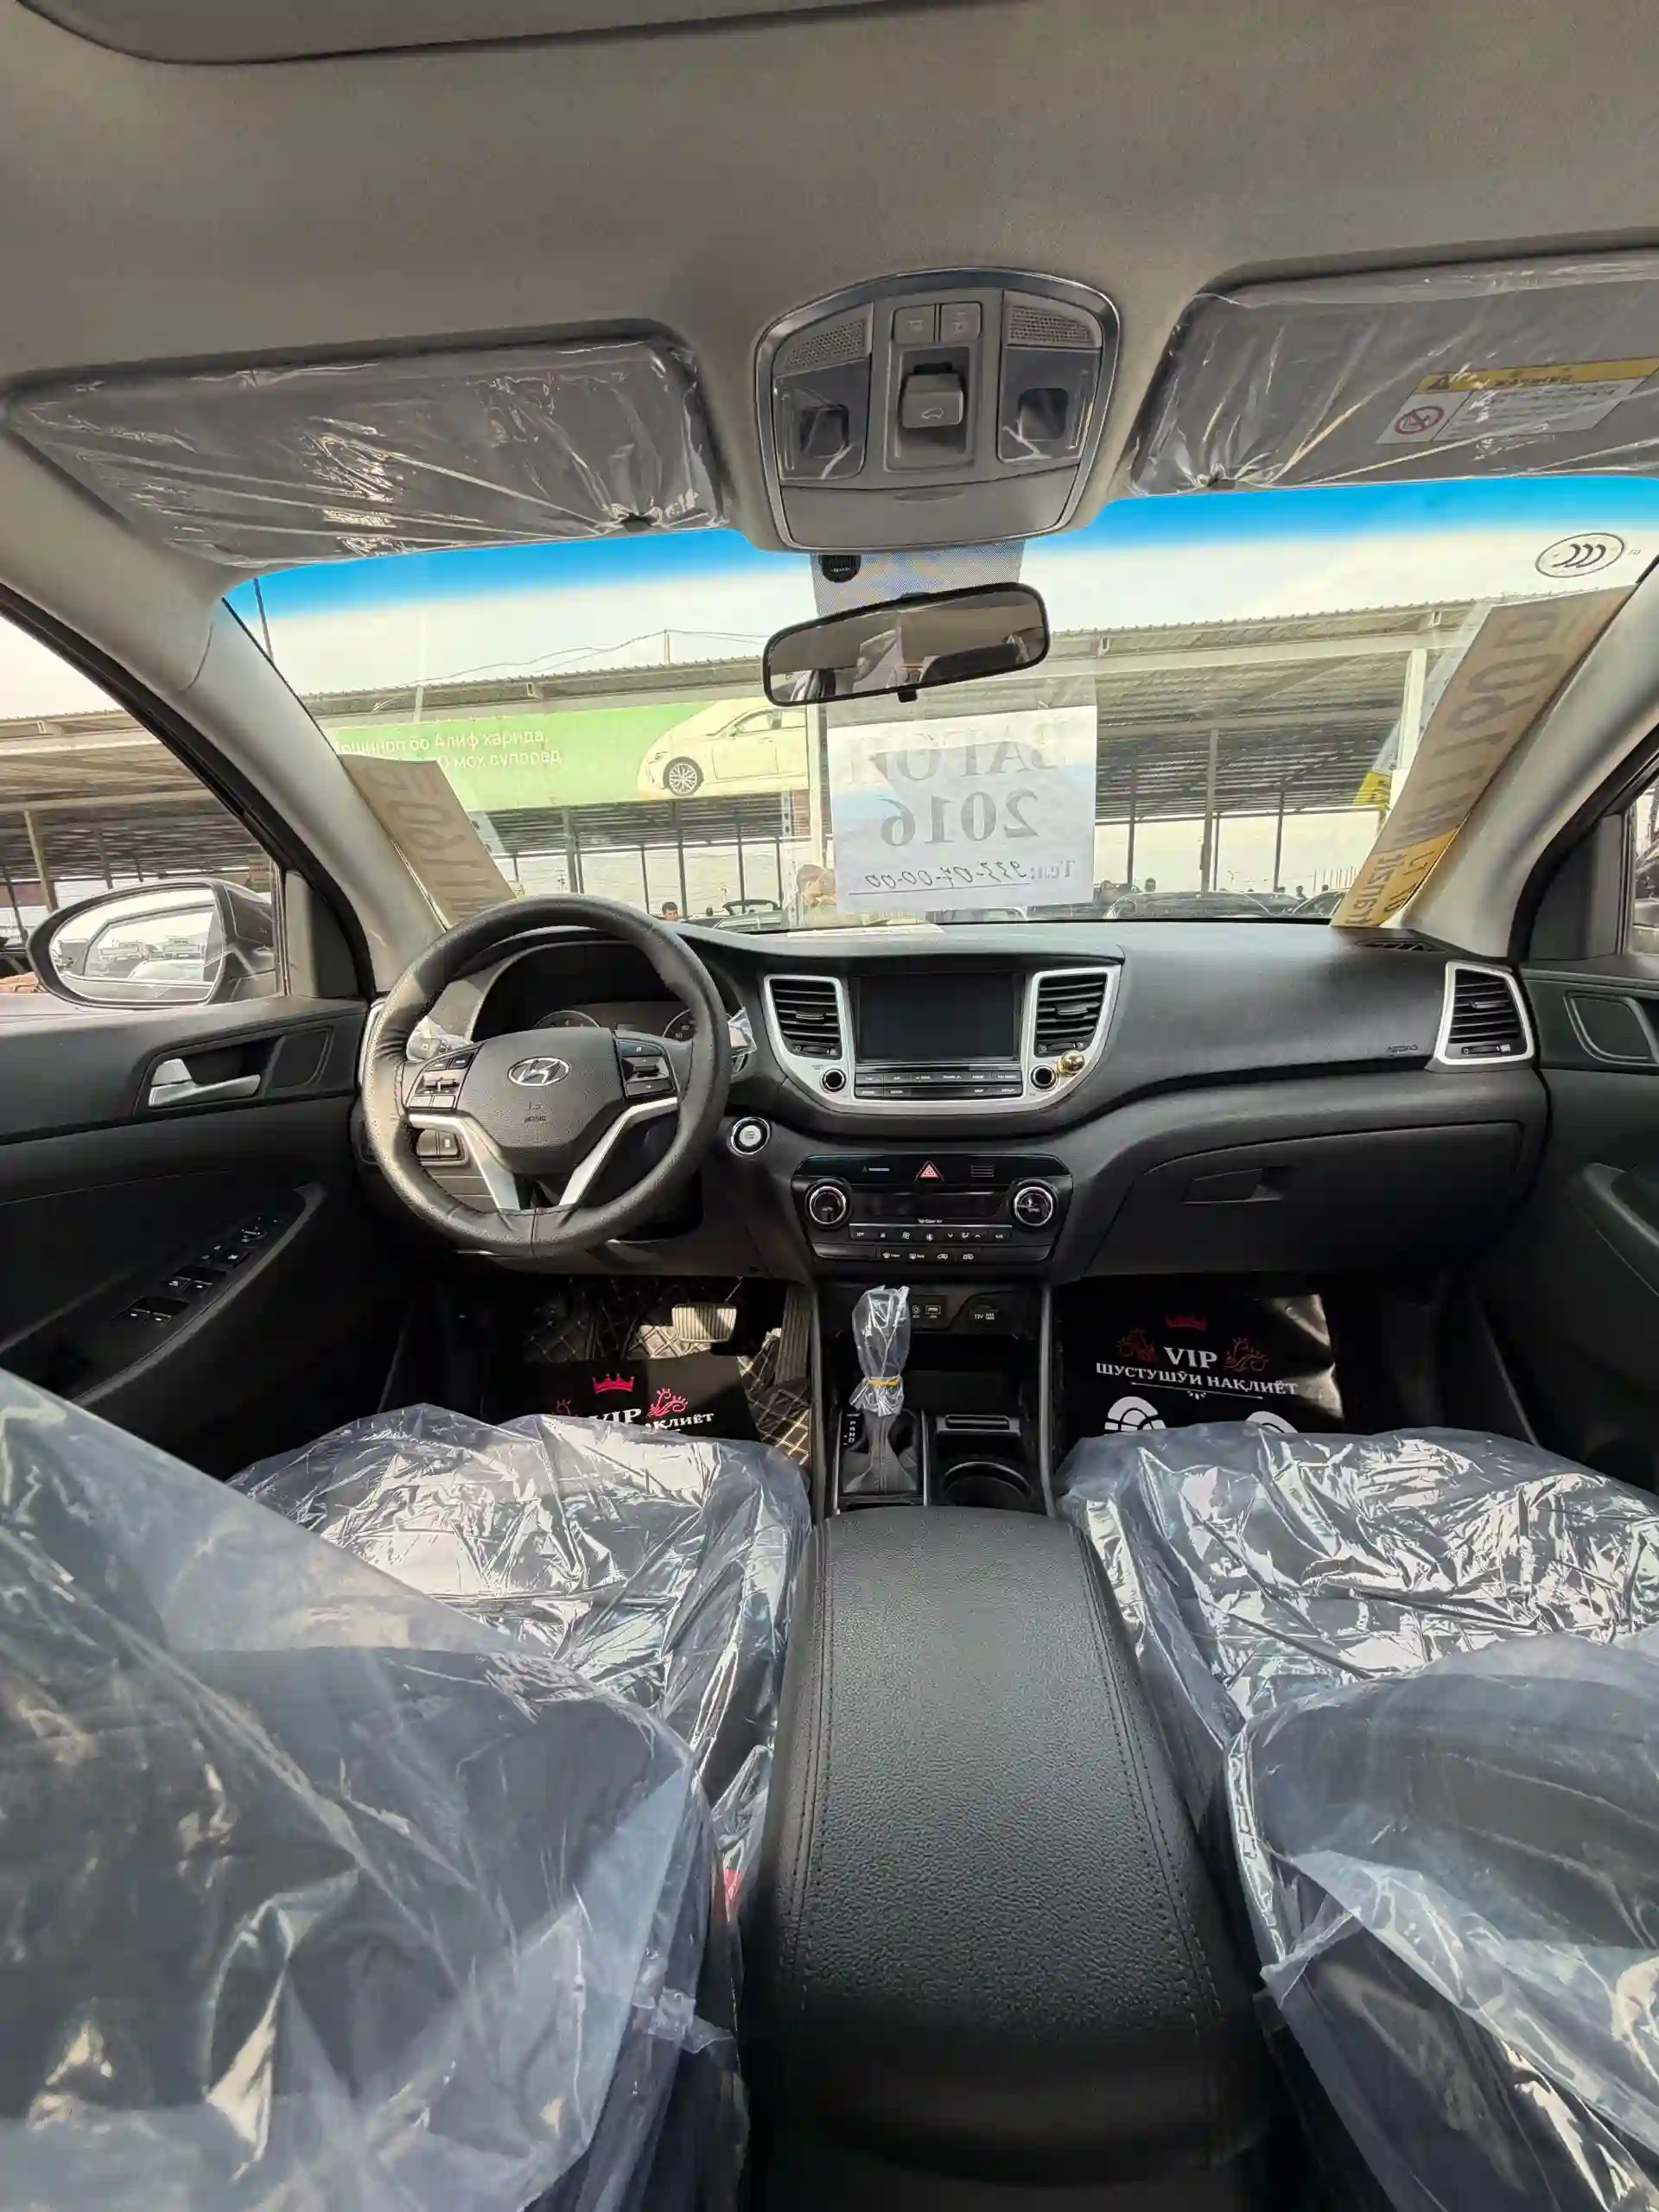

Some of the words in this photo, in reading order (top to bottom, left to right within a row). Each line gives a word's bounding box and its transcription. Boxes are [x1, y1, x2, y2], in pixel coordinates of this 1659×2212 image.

[410, 735, 430, 750] бо
[435, 731, 479, 751] Алиф
[1163, 1346, 1217, 1369] VIP
[588, 1408, 642, 1424] IP
